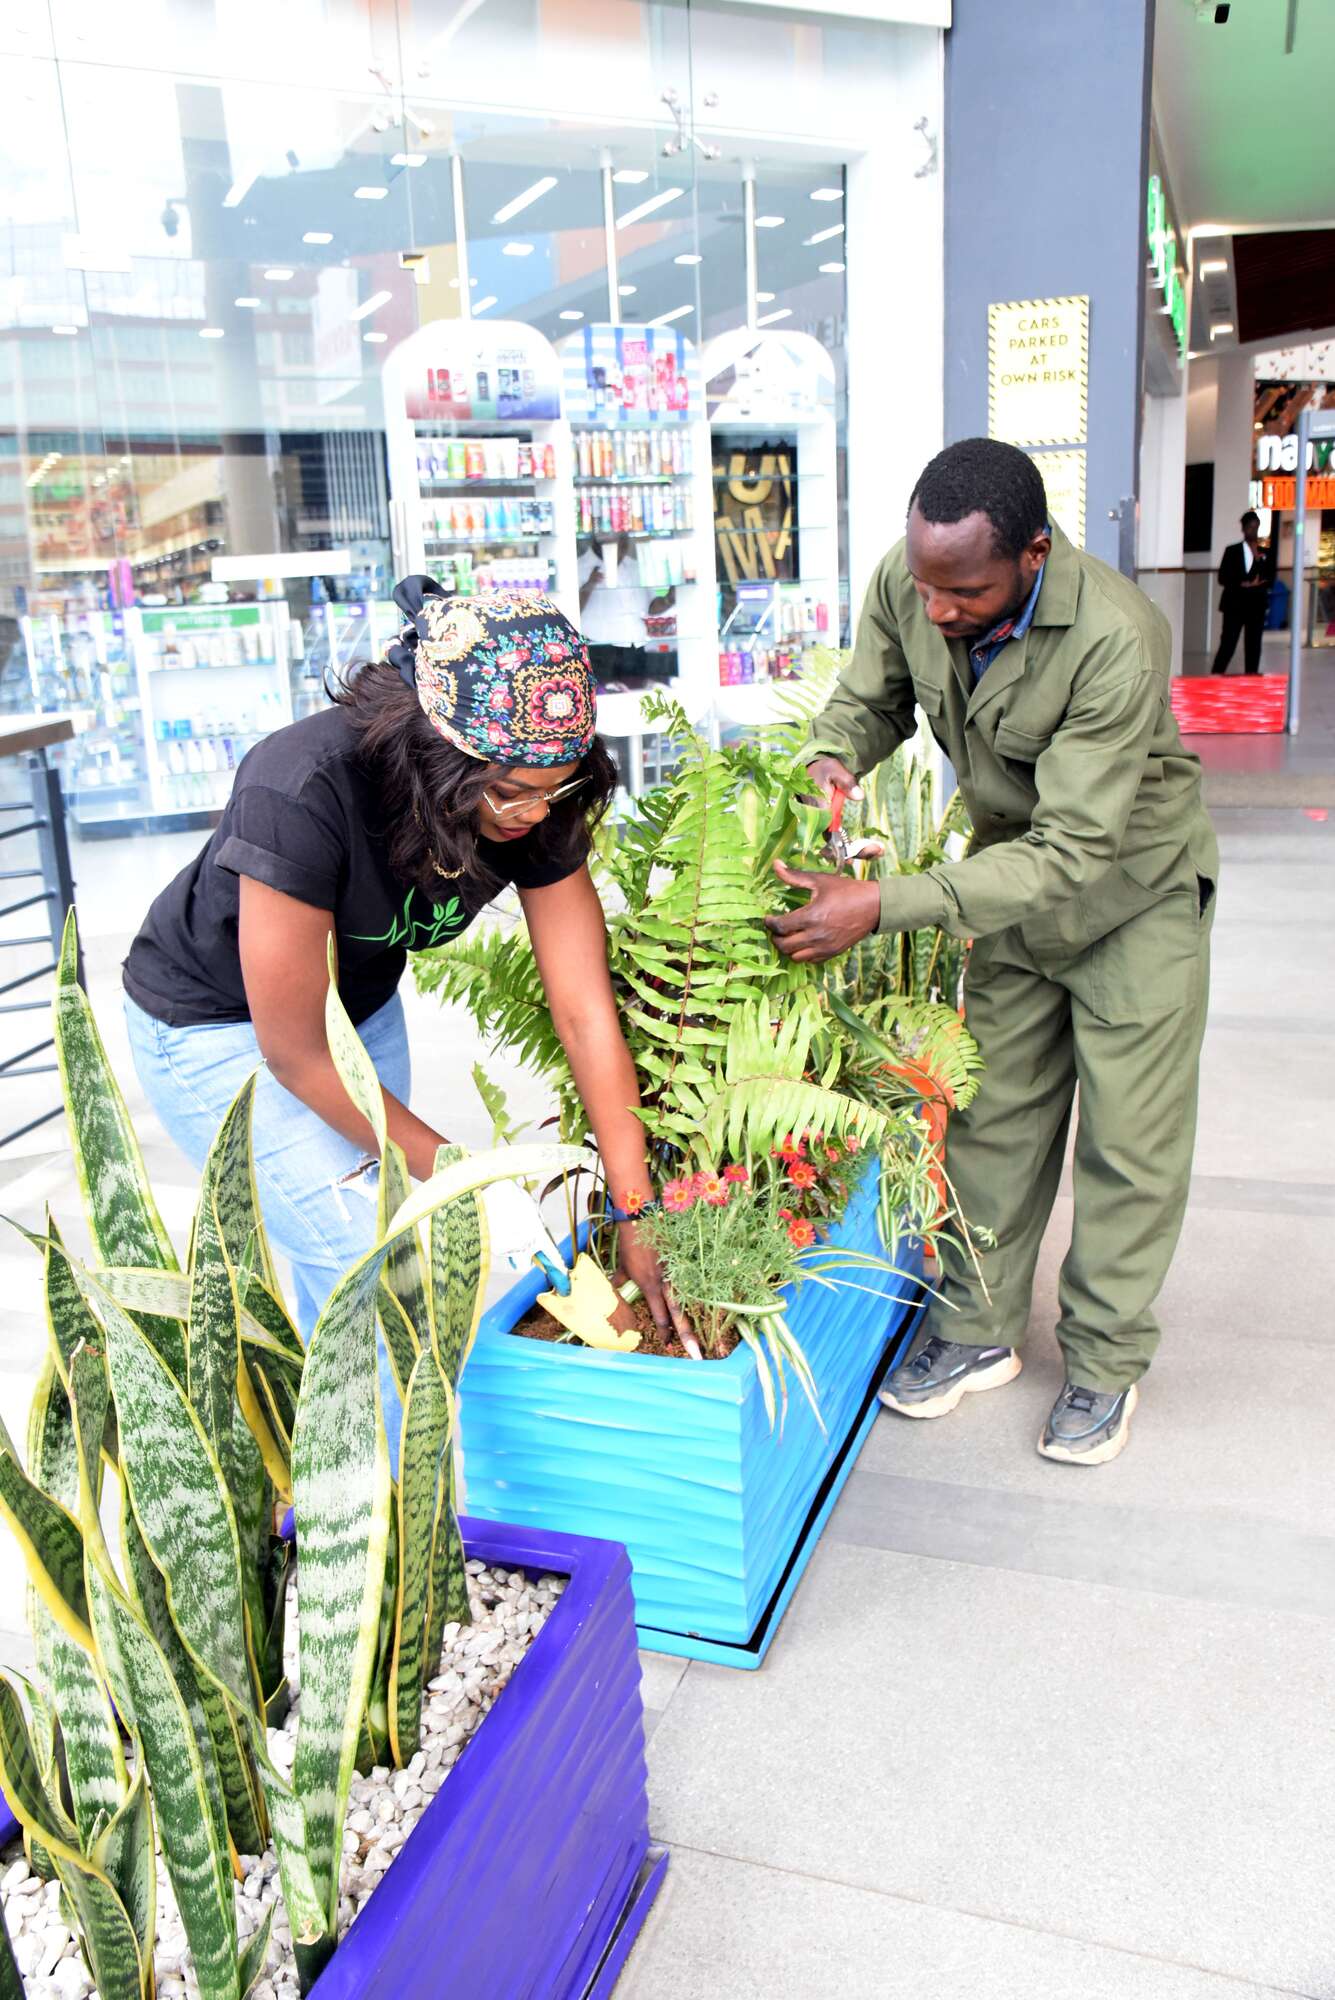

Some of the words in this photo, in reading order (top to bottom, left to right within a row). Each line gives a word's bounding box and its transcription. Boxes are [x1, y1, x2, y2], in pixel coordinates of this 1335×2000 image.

[1018, 316, 1060, 331] CARS
[1009, 334, 1068, 350] PARKED
[1030, 353, 1047, 365] AT
[1001, 372, 1037, 386] OWN
[1043, 369, 1076, 382] RISK
